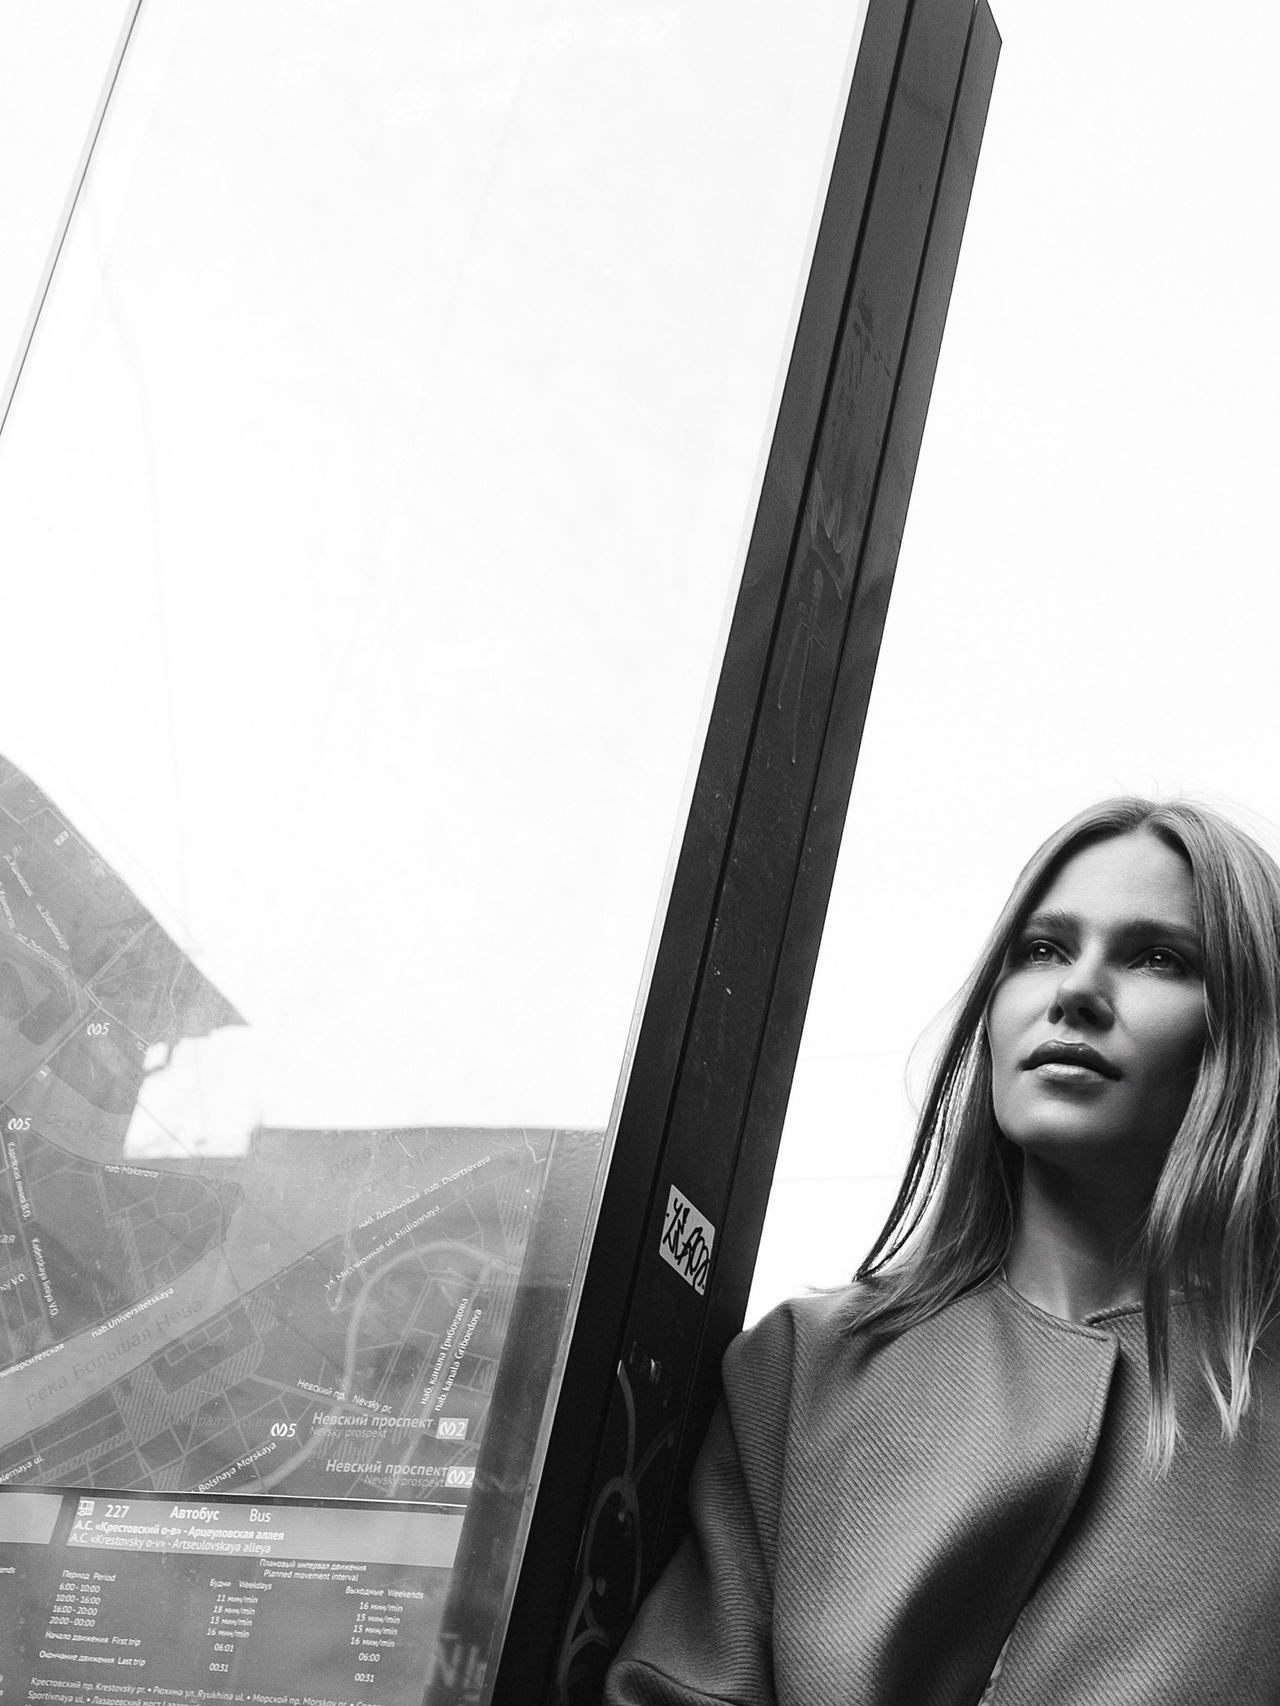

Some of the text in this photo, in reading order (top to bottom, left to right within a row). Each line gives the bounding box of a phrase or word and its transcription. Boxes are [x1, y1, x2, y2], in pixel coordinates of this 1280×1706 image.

[72, 1328, 152, 1380] Большая
[154, 1299, 204, 1334] Нева
[429, 1353, 447, 1385] канала
[440, 1298, 469, 1351] Грибоедова
[442, 1361, 460, 1391] kanala
[455, 1309, 482, 1359] Griboedova
[352, 1394, 381, 1412] Nevsky
[312, 1411, 435, 1430] Невский проспект
[326, 1459, 449, 1478] Невский проспект
[104, 1504, 272, 1524] 227 Автобус Bus
[187, 1525, 255, 1540] Арцеуловская
[255, 1531, 285, 1541] аллея
[171, 1538, 242, 1554] Artseulovskaya
[242, 1542, 272, 1556] alleya
[92, 1572, 117, 1582] Period
[263, 1568, 359, 1582] Planned movement interval
[238, 1580, 273, 1592] Weekdays
[111, 1636, 142, 1647] First trip
[213, 1642, 234, 1653] 06:01
[117, 1656, 146, 1667] Last trip
[358, 1652, 381, 1663] 06:00
[208, 1662, 229, 1673] 00:31
[354, 1672, 375, 1683] 00:31
[30, 1677, 82, 1689] Крестовский
[94, 1682, 137, 1695] Krestovsky
[26, 1690, 74, 1704] Sportivnaya
